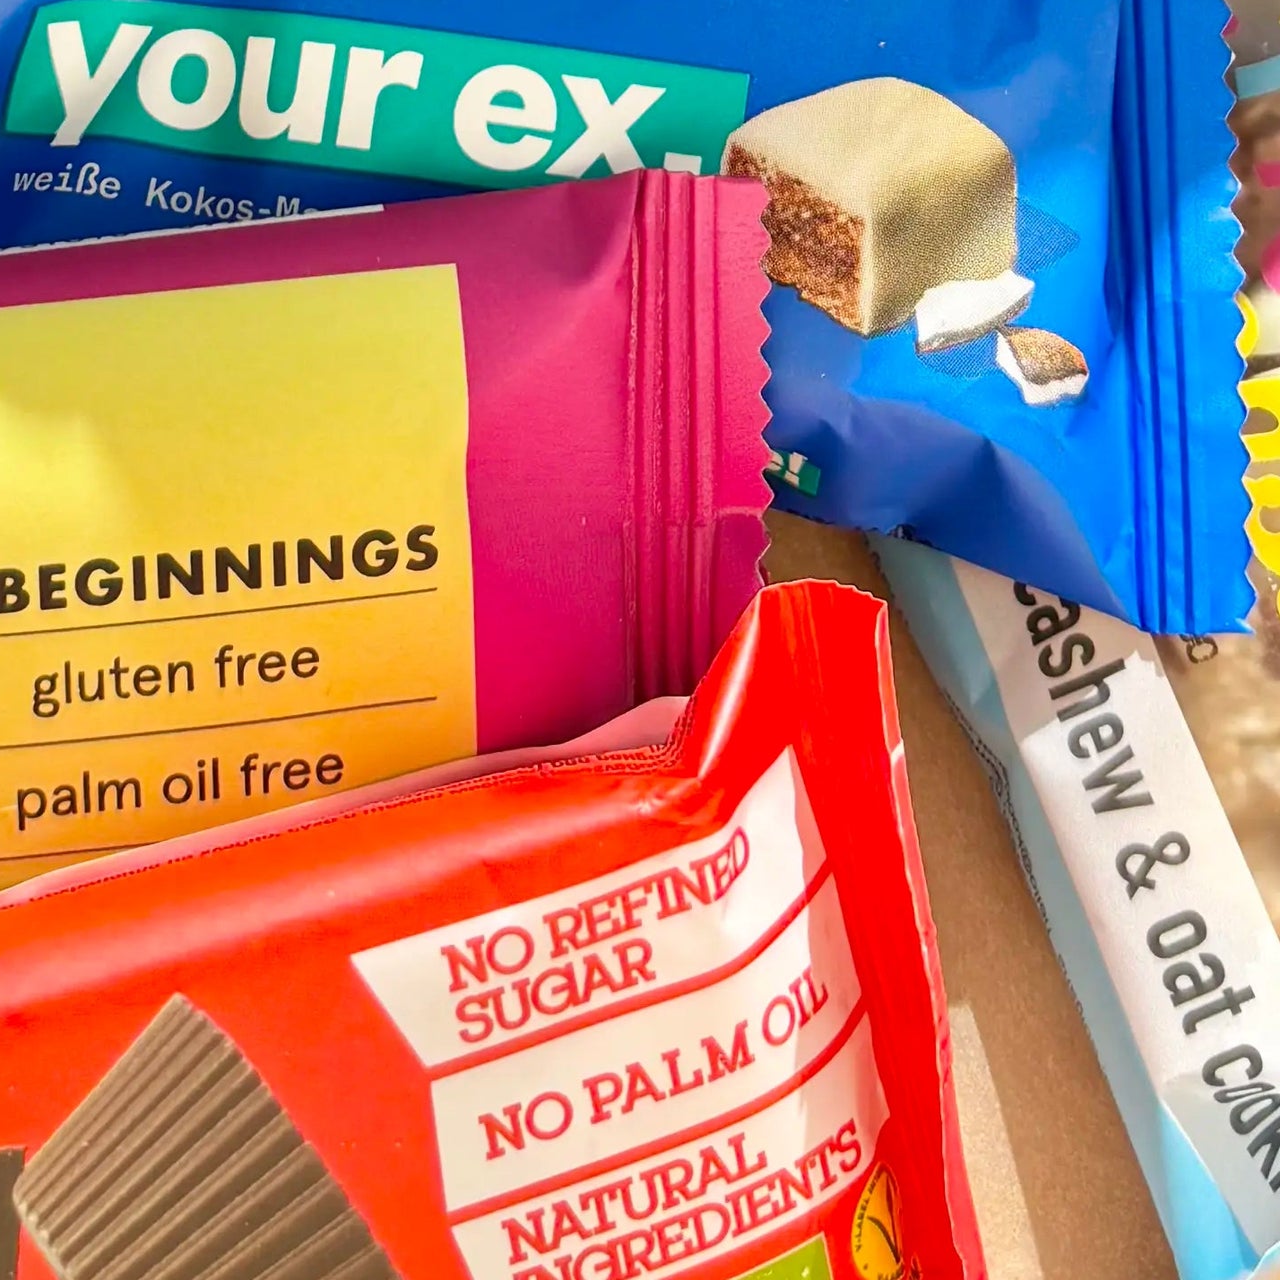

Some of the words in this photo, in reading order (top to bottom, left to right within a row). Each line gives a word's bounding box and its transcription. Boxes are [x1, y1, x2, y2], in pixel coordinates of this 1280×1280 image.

[43, 18, 424, 151] your
[452, 67, 705, 179] ex.
[12, 161, 122, 200] weiße
[29, 651, 194, 720] gluten
[212, 641, 321, 690] free
[14, 773, 143, 834] palm
[160, 763, 222, 806] oil
[239, 748, 346, 797] free
[439, 926, 535, 996] NO
[542, 826, 751, 956] REFINED
[1116, 830, 1192, 901] &
[453, 938, 658, 1045] SUGAR
[1146, 909, 1257, 1036] oat
[478, 1090, 572, 1162] NO
[582, 1018, 756, 1126] PALM
[762, 969, 828, 1049] OIL
[501, 1132, 768, 1266] NATURAL
[512, 1119, 862, 1280] NGREDIENTS
